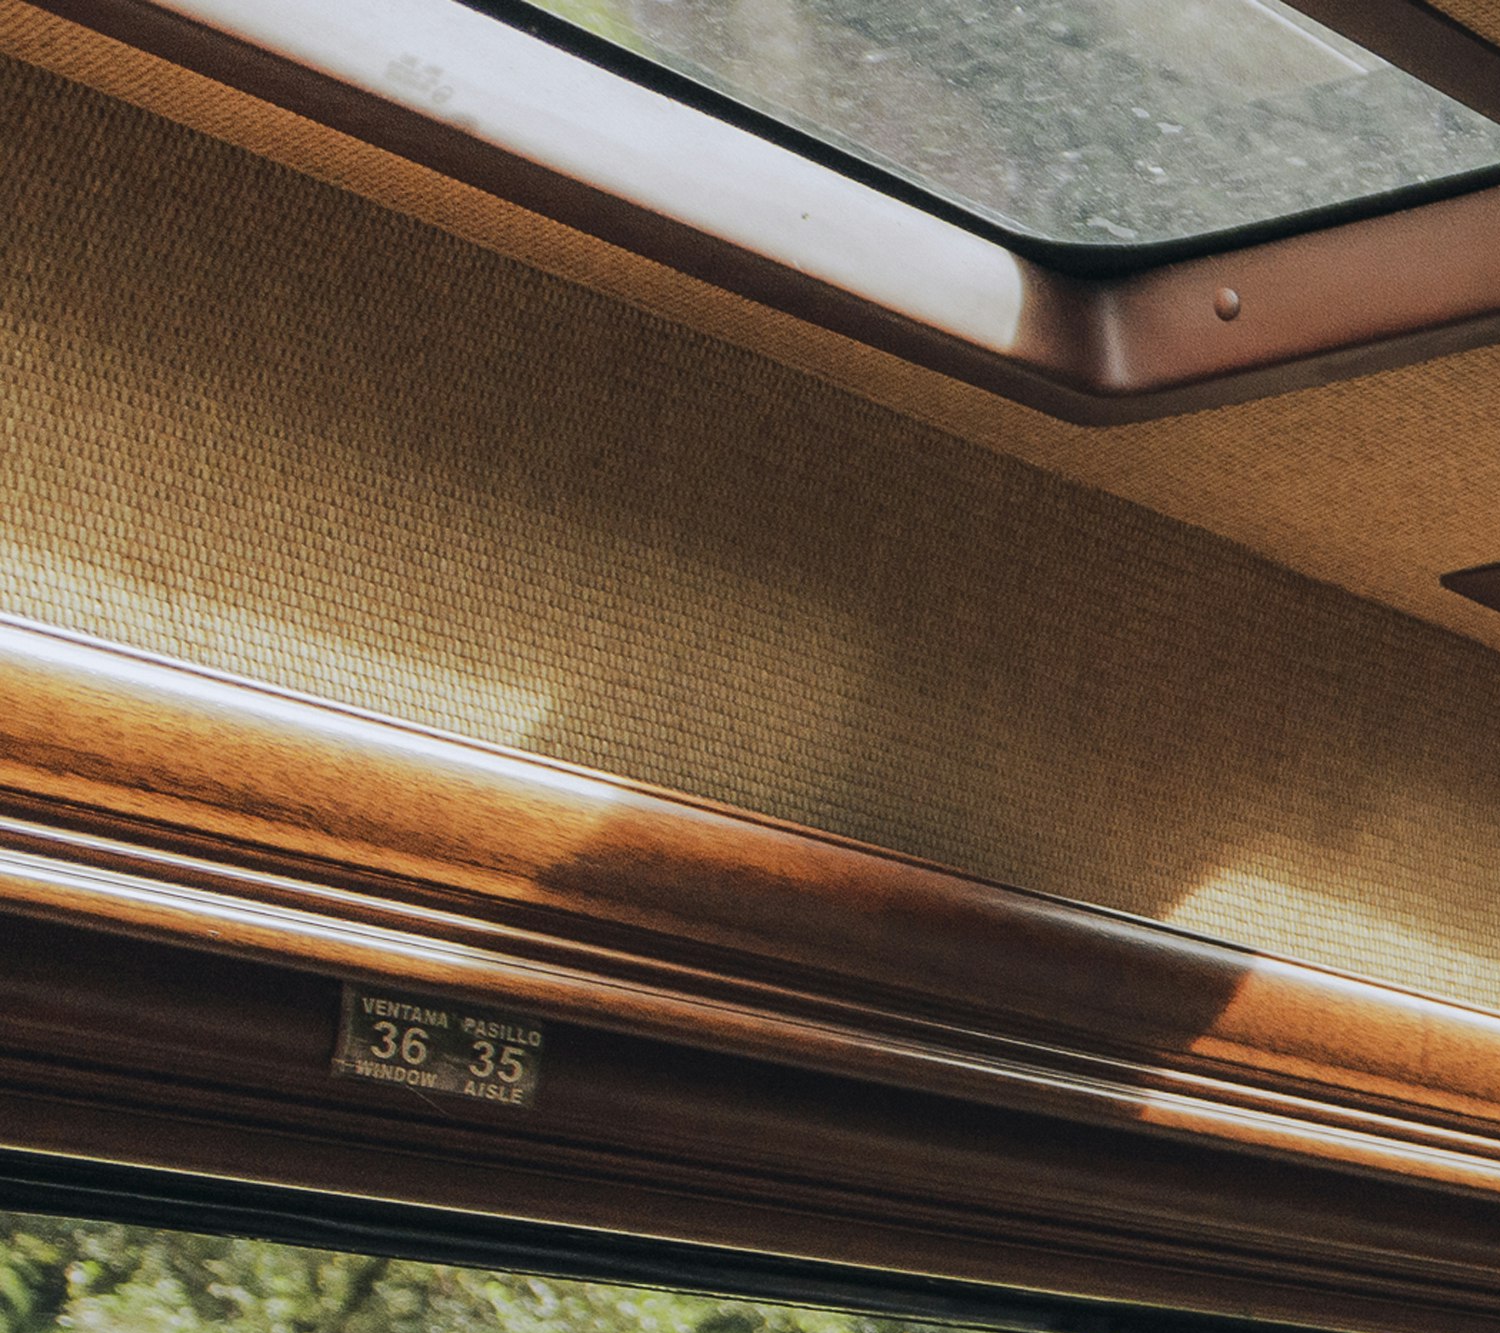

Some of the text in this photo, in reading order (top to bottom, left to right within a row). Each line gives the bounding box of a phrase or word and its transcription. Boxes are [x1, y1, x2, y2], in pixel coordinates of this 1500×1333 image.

[362, 997, 542, 1048] VENTANA PASILLO
[370, 1020, 524, 1084] 36 35
[354, 1059, 524, 1105] WINDOW AISLE
